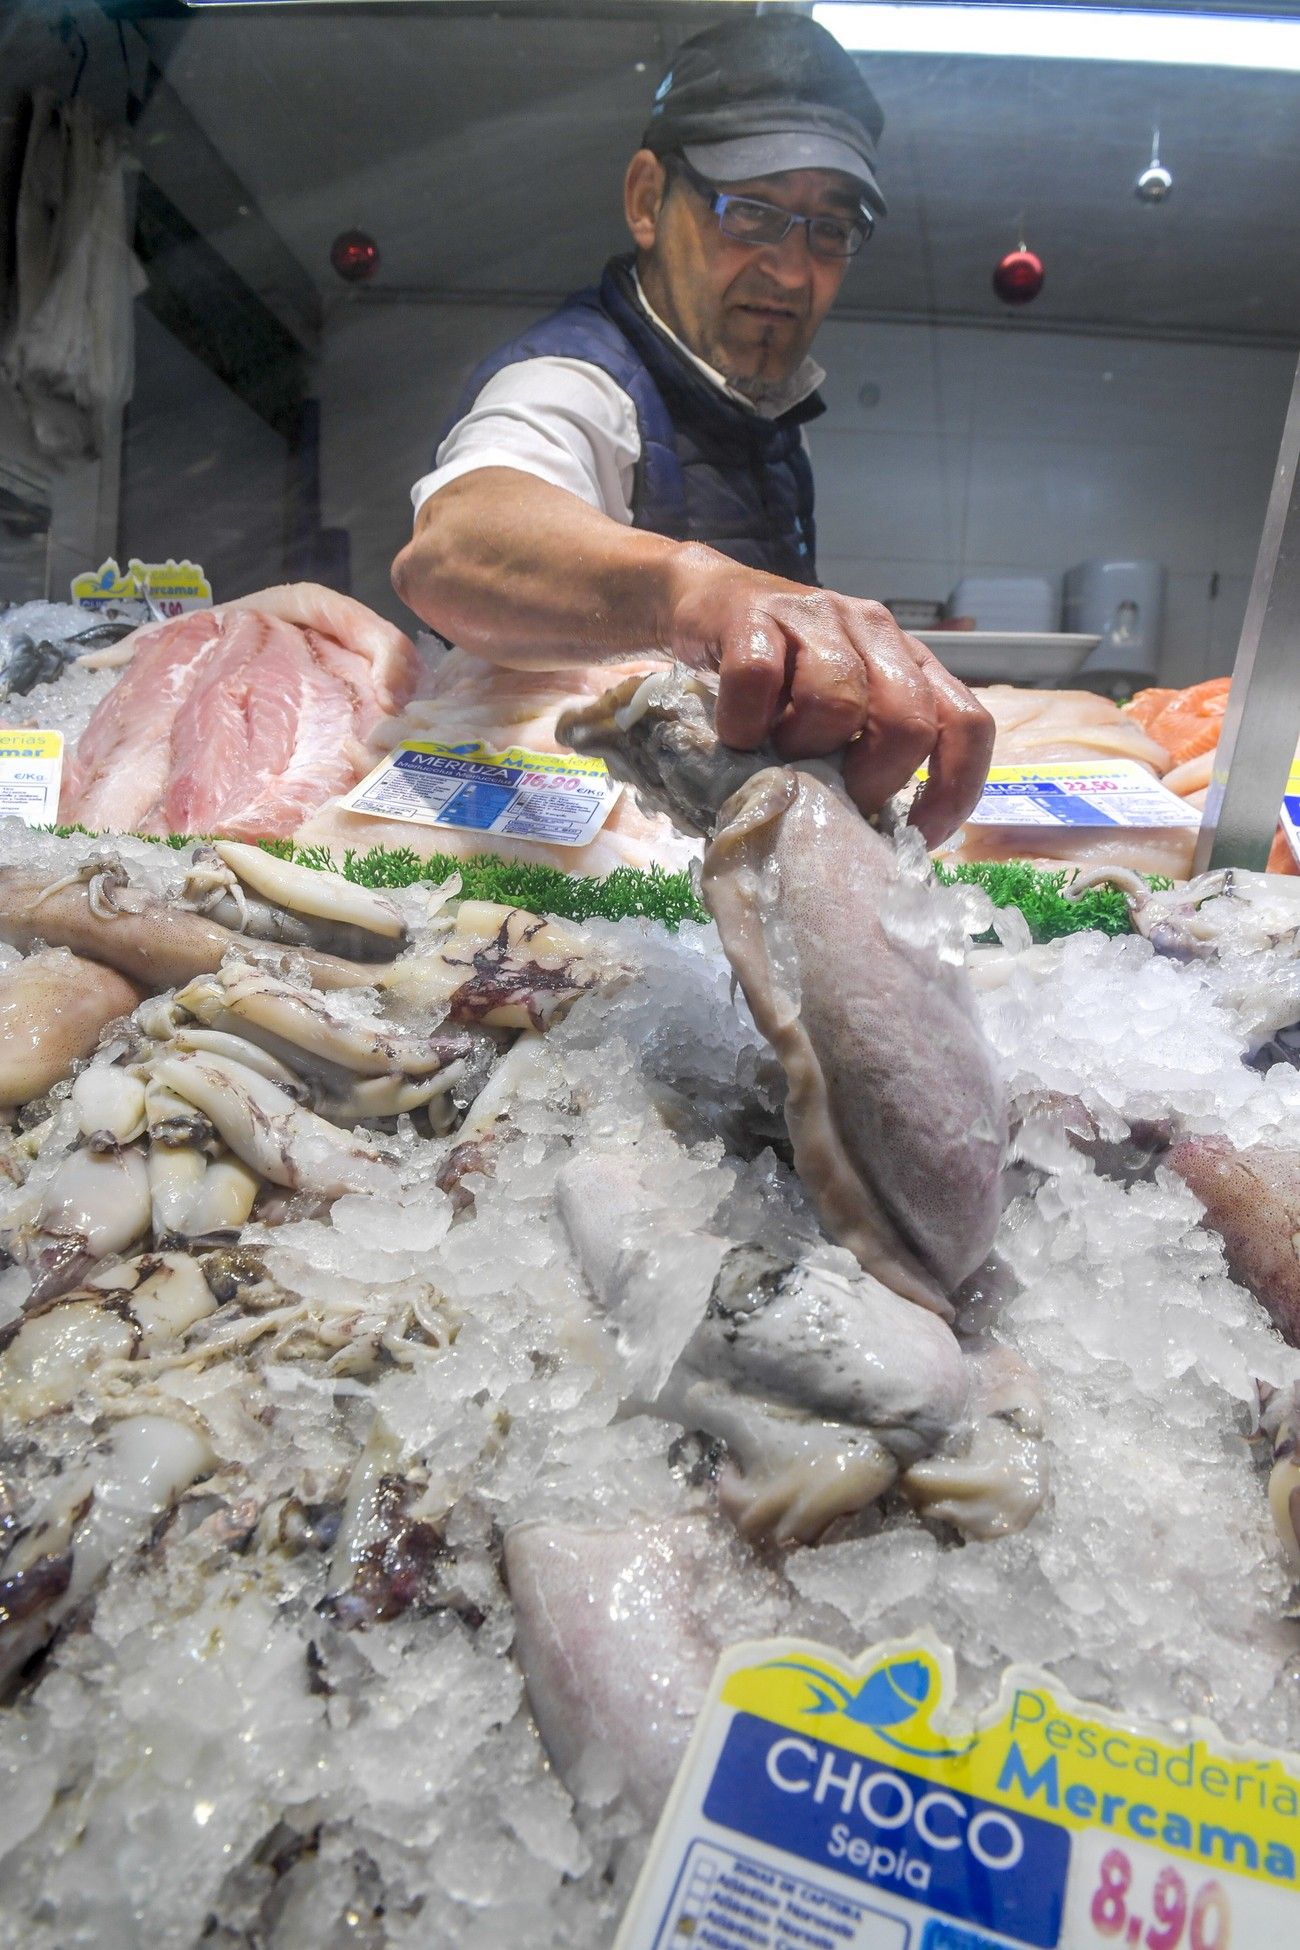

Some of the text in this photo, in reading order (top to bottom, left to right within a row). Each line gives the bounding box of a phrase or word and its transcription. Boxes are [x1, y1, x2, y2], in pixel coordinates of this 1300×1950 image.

[412, 754, 508, 779] MERLUZA
[521, 773, 581, 791] 16,90
[1063, 780, 1119, 793] 22,50
[765, 1737, 1025, 1871] CHOCO
[826, 1821, 932, 1891] Sepia
